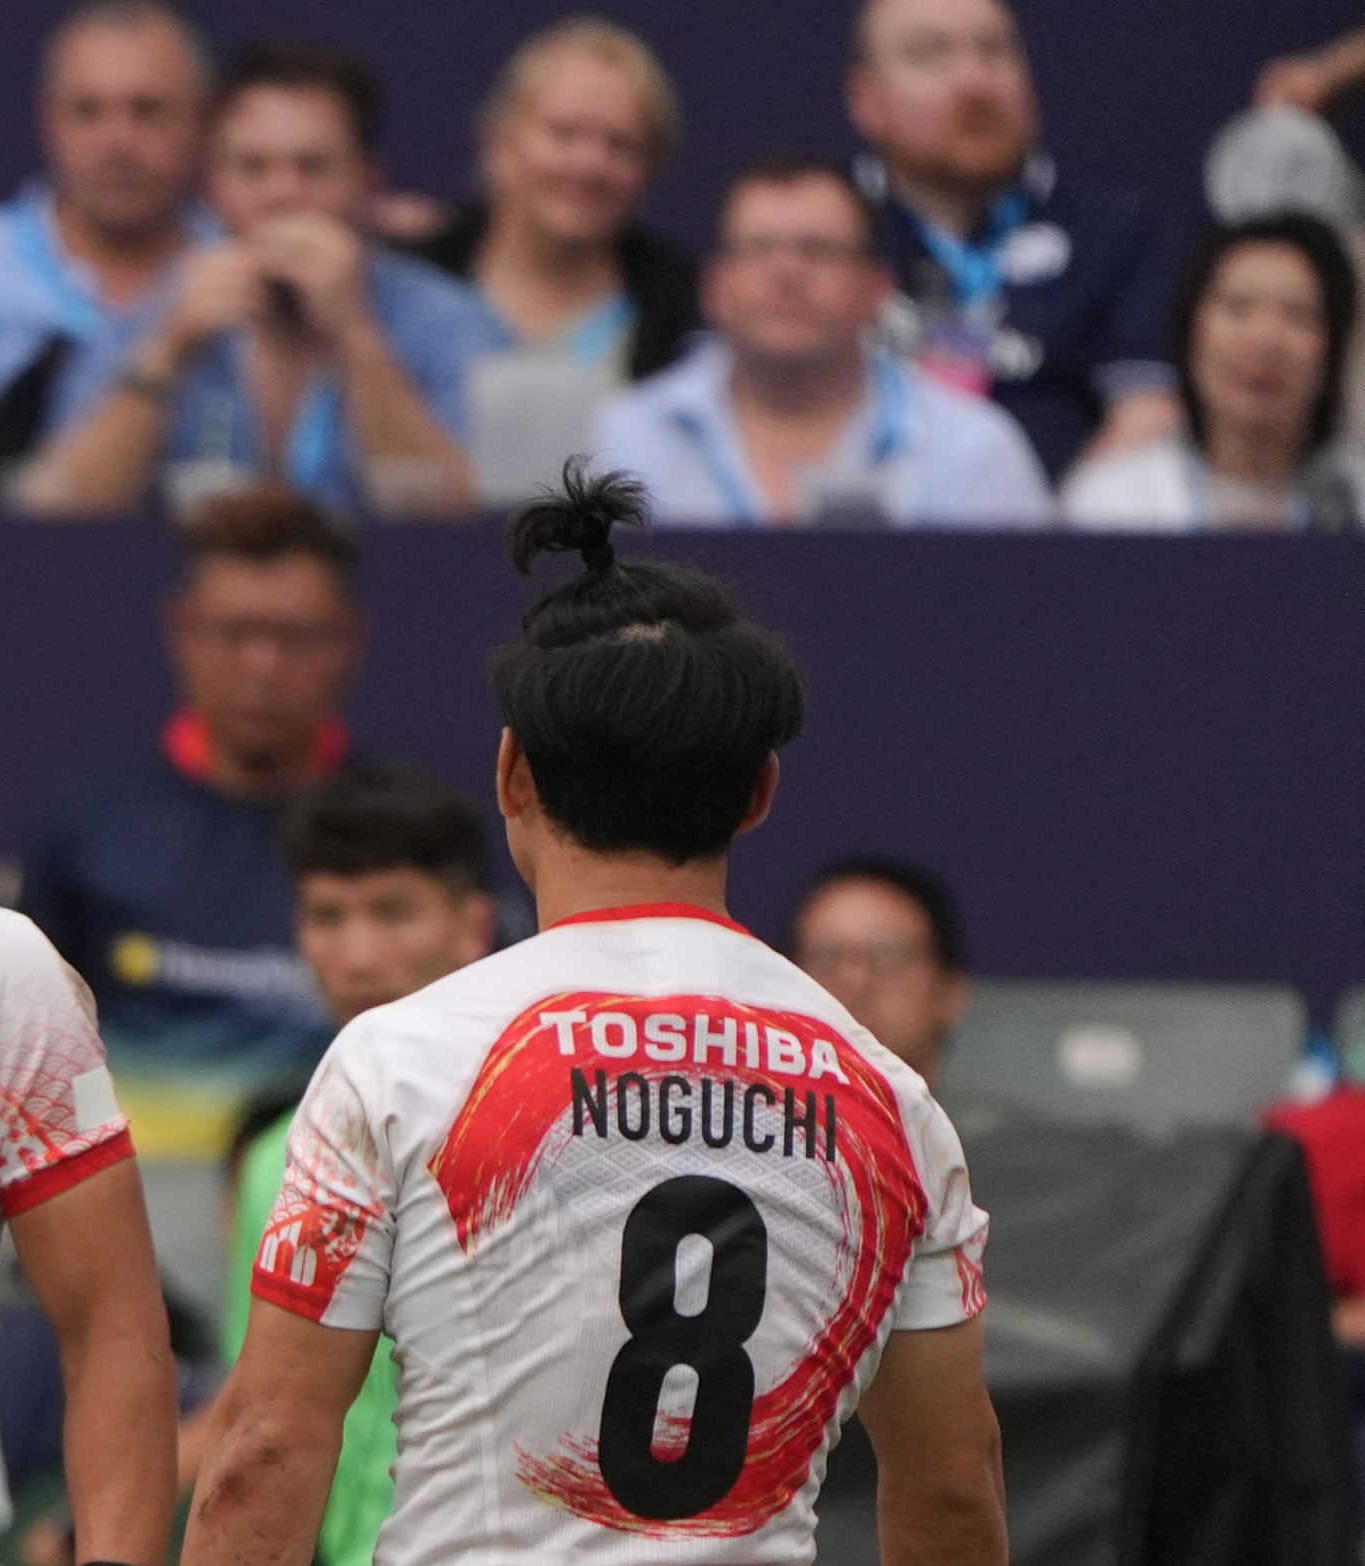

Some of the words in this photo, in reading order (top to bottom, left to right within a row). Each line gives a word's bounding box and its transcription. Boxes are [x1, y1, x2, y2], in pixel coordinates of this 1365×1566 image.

[539, 1009, 850, 1086] TOSHIBA
[571, 1066, 838, 1163] NOGUCHI
[597, 1174, 768, 1521] 8
